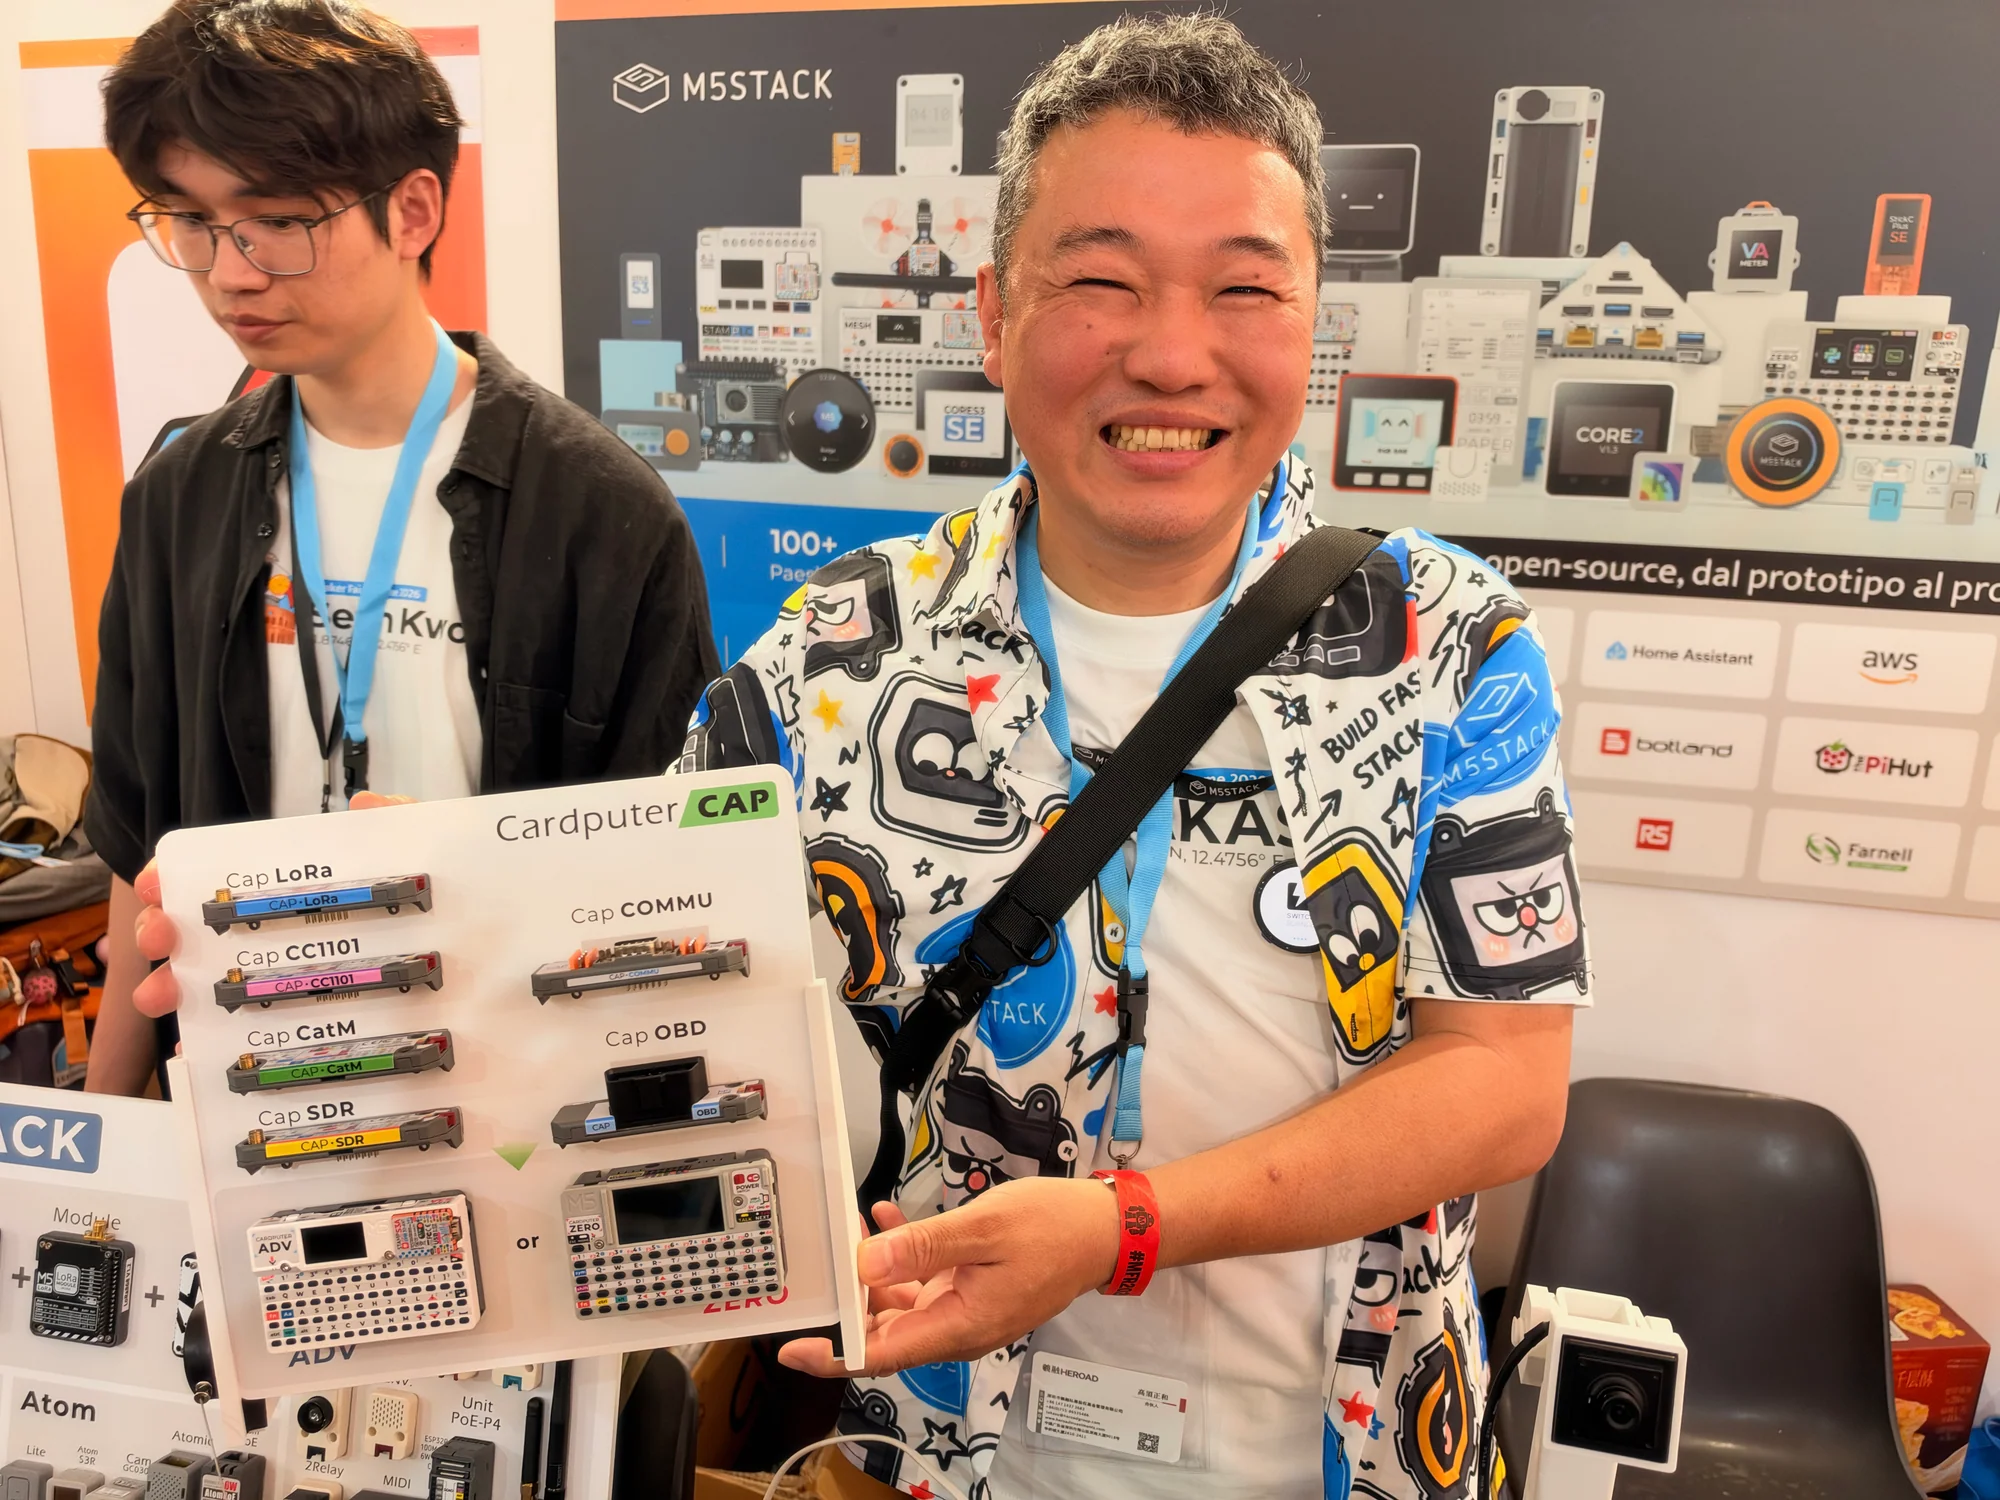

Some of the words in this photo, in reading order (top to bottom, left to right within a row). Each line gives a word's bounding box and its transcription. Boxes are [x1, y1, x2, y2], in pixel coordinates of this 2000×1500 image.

[683, 69, 833, 102] M5STACK
[1890, 232, 1908, 243] SE
[1742, 242, 1769, 258] VA
[632, 281, 649, 294] S3
[946, 417, 982, 440] SE
[1576, 426, 1644, 444] CORE2
[769, 528, 838, 555] 100+
[1486, 554, 1684, 589] open-source,
[1692, 559, 1740, 587] dal
[1748, 566, 1906, 603] prototipo
[1914, 572, 1944, 600] al
[1633, 645, 1679, 662] Home
[1683, 649, 1754, 666] Assistant
[1862, 651, 1918, 671] aws
[1320, 707, 1379, 763] BUILD
[1353, 719, 1424, 789] STACK
[1443, 720, 1551, 788] M5STACK
[1636, 737, 1733, 759] botland
[1210, 784, 1260, 796] M5STACK
[496, 802, 678, 842] Cardputer
[697, 789, 769, 817] CAP
[1172, 799, 1292, 847] KA
[1638, 822, 1670, 846] RS
[1192, 850, 1266, 867] 12.4756°
[1848, 843, 1913, 862] Farnell
[227, 872, 269, 888] Cap
[275, 864, 333, 883] LoRa
[571, 907, 614, 924] Cap
[621, 892, 713, 918] COMMU
[237, 950, 279, 967] Cap
[286, 938, 360, 961] CC1101
[986, 1000, 1047, 1025] TACK
[247, 1030, 290, 1047] Cap
[296, 1020, 356, 1041] CatM
[605, 1031, 648, 1047] Cap
[655, 1020, 706, 1041] OBD
[258, 1109, 301, 1127] Cap
[307, 1101, 354, 1121] SDR
[592, 1122, 610, 1132] CAP
[697, 1107, 717, 1117] OBD
[569, 1223, 600, 1233] ZERO
[258, 1241, 292, 1254] ADV
[516, 1236, 539, 1250] or
[37, 1272, 53, 1285] M5
[57, 1272, 77, 1282] LoRa
[21, 1391, 96, 1421] Atom
[463, 1396, 493, 1412] Unit
[451, 1411, 501, 1431] PoE-P4
[26, 1445, 46, 1457] Lite
[77, 1446, 98, 1455] Atom
[79, 1455, 96, 1465] S3R
[127, 1454, 151, 1466] Cam
[305, 1461, 345, 1478] 2Relay
[383, 1475, 411, 1489] MIDI
